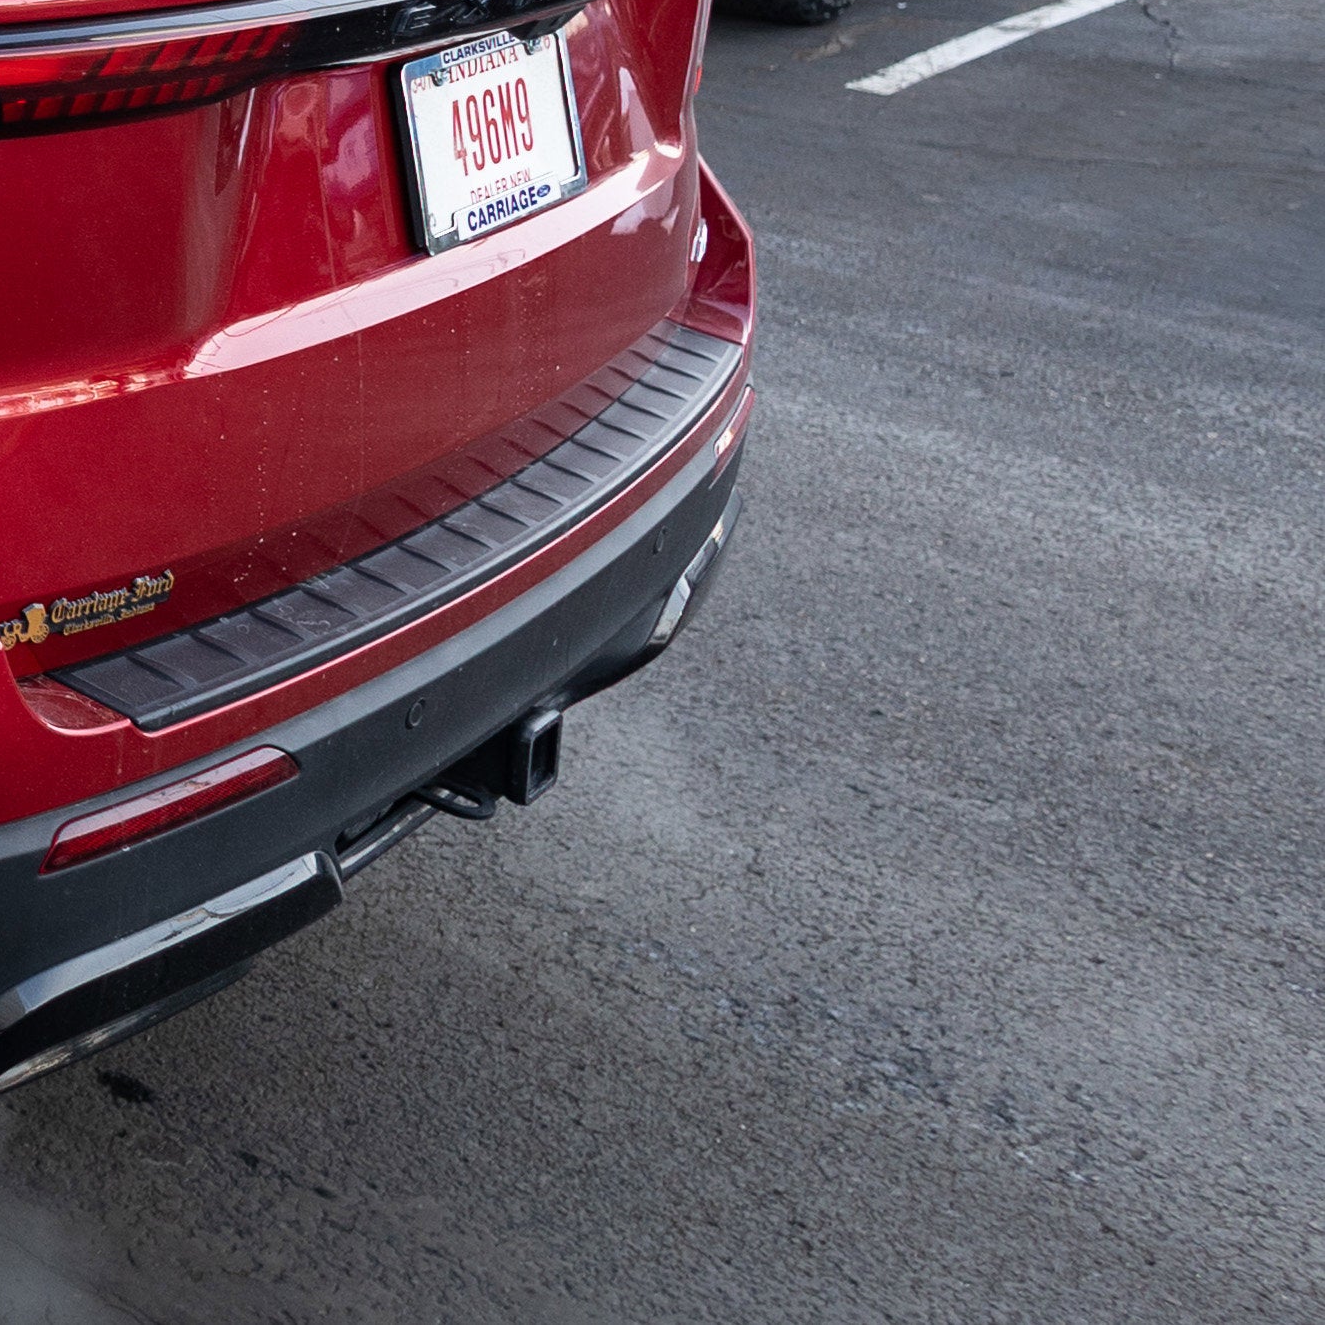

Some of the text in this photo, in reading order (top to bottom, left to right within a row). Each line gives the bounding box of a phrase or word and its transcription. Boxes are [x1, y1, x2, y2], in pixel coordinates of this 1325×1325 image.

[449, 46, 519, 83] INDIANA
[452, 78, 534, 176] 496M9
[467, 186, 538, 231] CARRIAGE
[470, 177, 509, 205] DEALER
[510, 167, 532, 188] NEW
[51, 568, 175, 625] Carriage Ford
